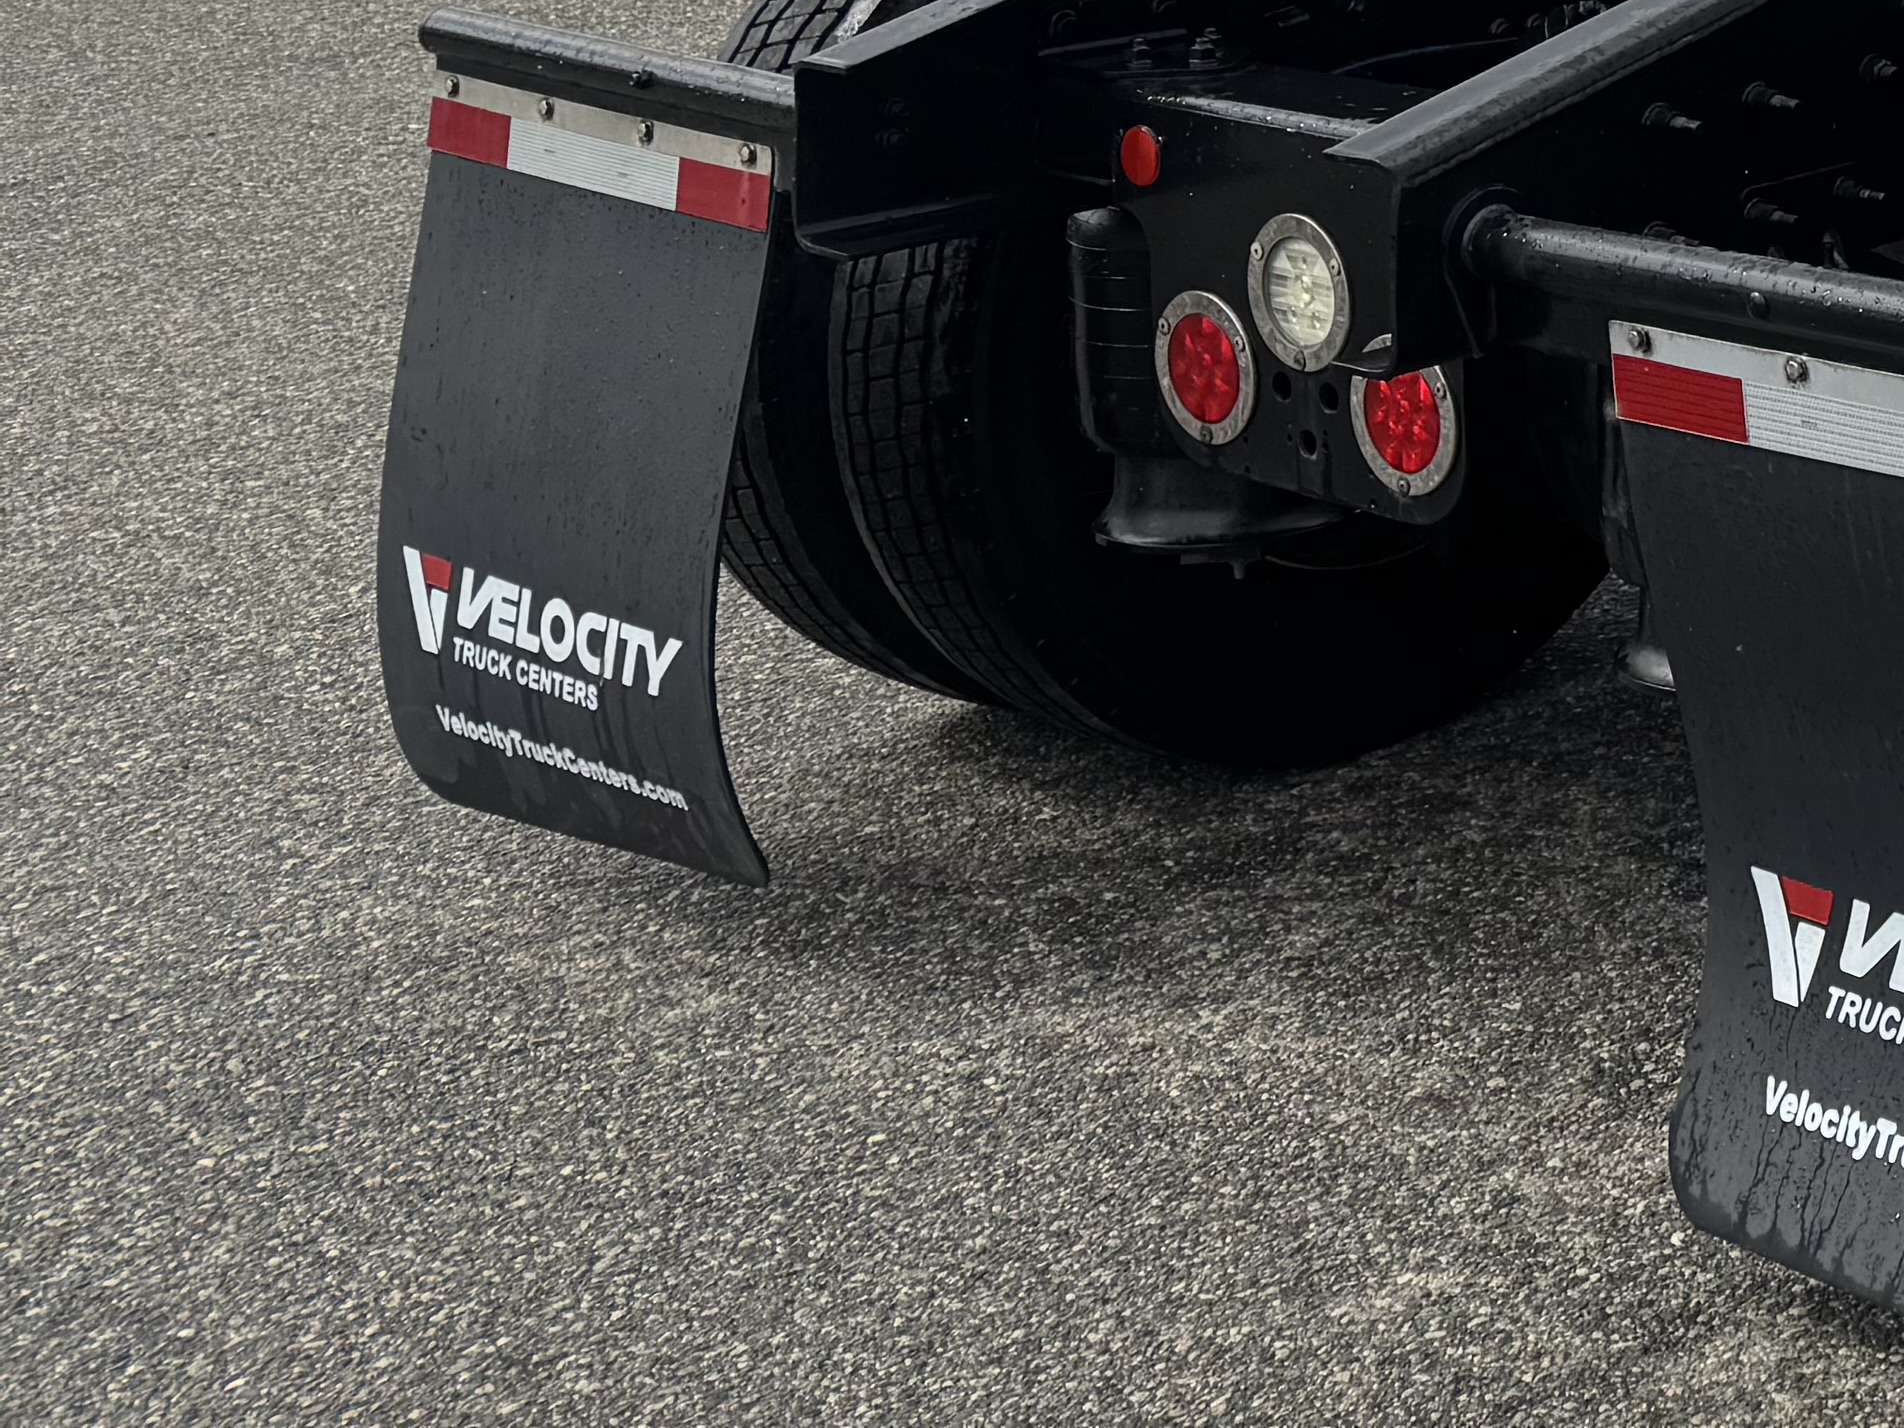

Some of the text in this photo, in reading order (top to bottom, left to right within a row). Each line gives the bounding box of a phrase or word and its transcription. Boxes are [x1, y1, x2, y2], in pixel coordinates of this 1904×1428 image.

[453, 636, 599, 711] TRUCK CENTERS
[457, 567, 683, 697] VELOCITY
[435, 704, 689, 811] VelocityTruckCenters.com
